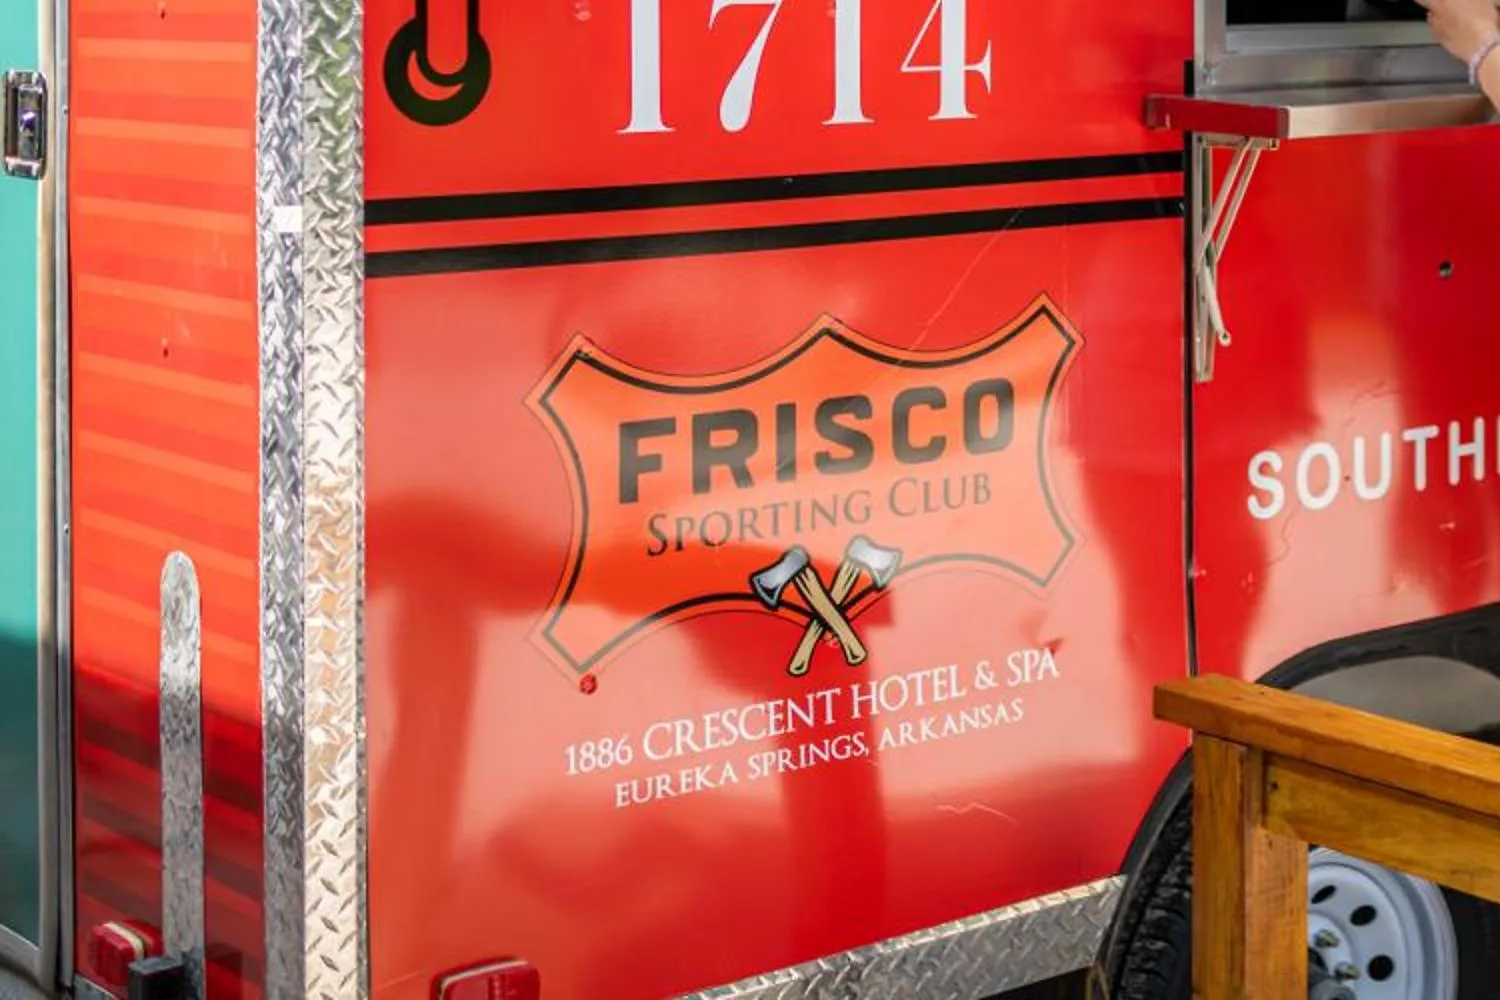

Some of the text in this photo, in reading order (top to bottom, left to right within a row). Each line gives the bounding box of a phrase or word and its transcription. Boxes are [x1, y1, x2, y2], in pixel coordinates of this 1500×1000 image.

[618, 377, 1015, 504] FRISCO
[647, 471, 992, 557] SPORTING CLUB
[564, 647, 1060, 775] 1886 CRESCENT HOTEL & SPA
[614, 697, 1025, 808] EUREKA SPRINGS, ARKANSAS
